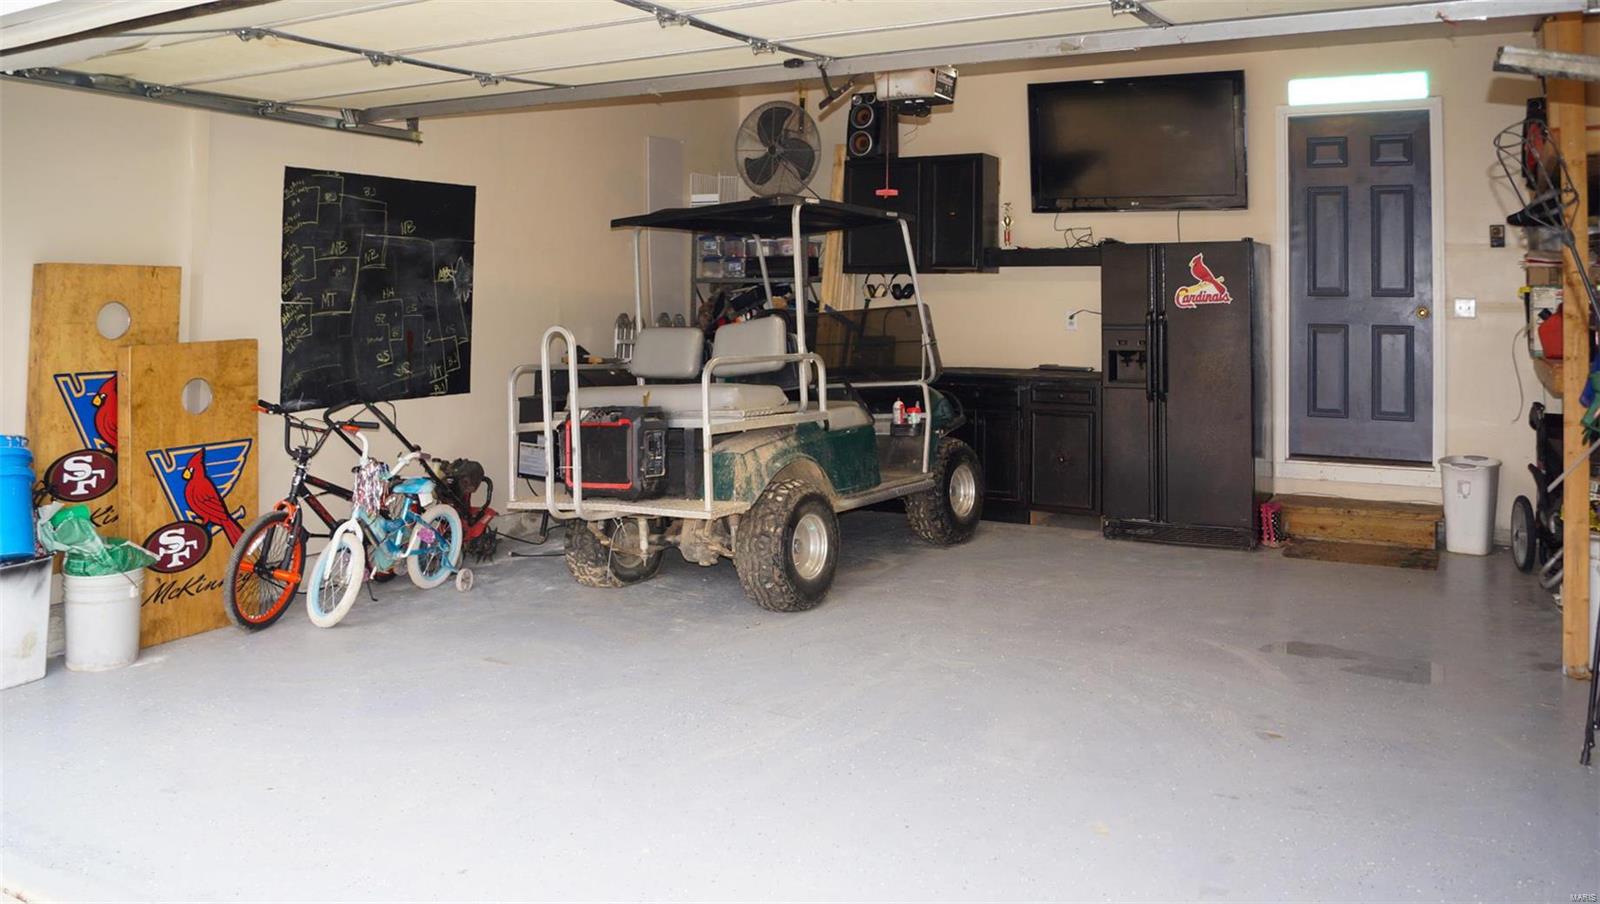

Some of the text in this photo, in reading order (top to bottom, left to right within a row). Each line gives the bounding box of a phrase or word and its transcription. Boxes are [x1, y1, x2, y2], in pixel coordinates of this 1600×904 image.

[1175, 286, 1233, 309] Cardinals
[62, 454, 106, 496] SF
[158, 527, 199, 568] SF
